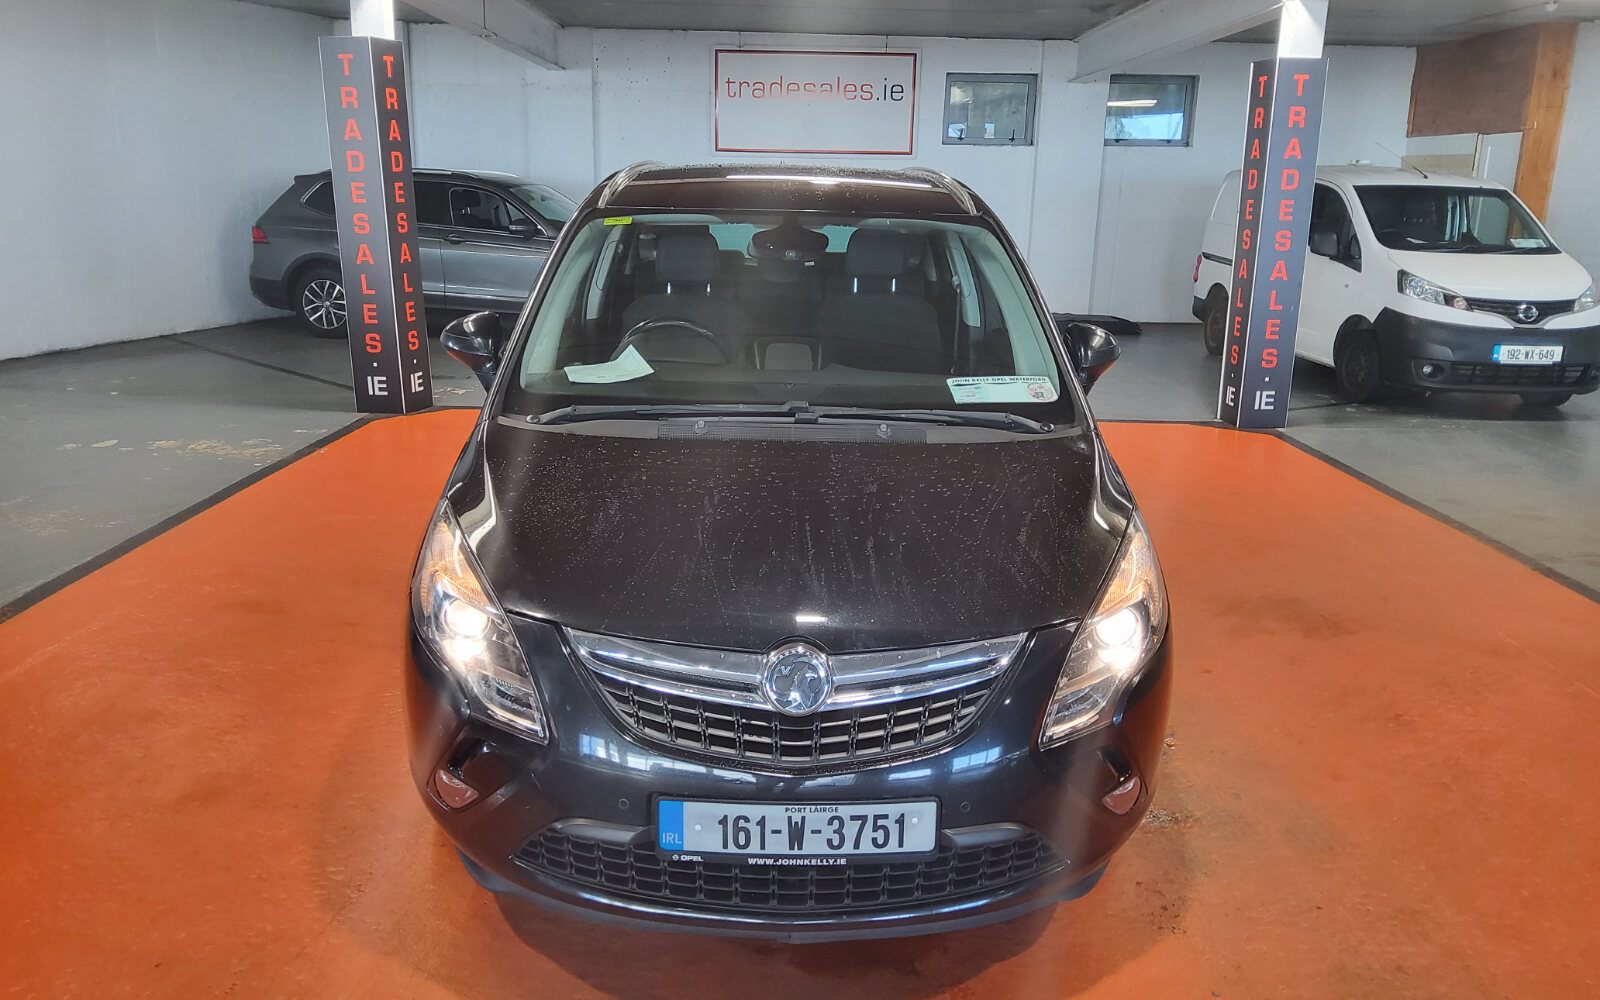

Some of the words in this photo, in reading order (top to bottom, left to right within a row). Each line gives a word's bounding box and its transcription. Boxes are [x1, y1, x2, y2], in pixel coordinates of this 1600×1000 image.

[725, 75, 904, 102] tradesales.ie
[1506, 349, 1555, 361] 192-WX-649
[662, 831, 682, 844] IRL
[718, 812, 905, 851] 161-W-3751
[680, 854, 704, 862] OPEL
[747, 857, 847, 866] WWW.JOHNKELLY.IE
